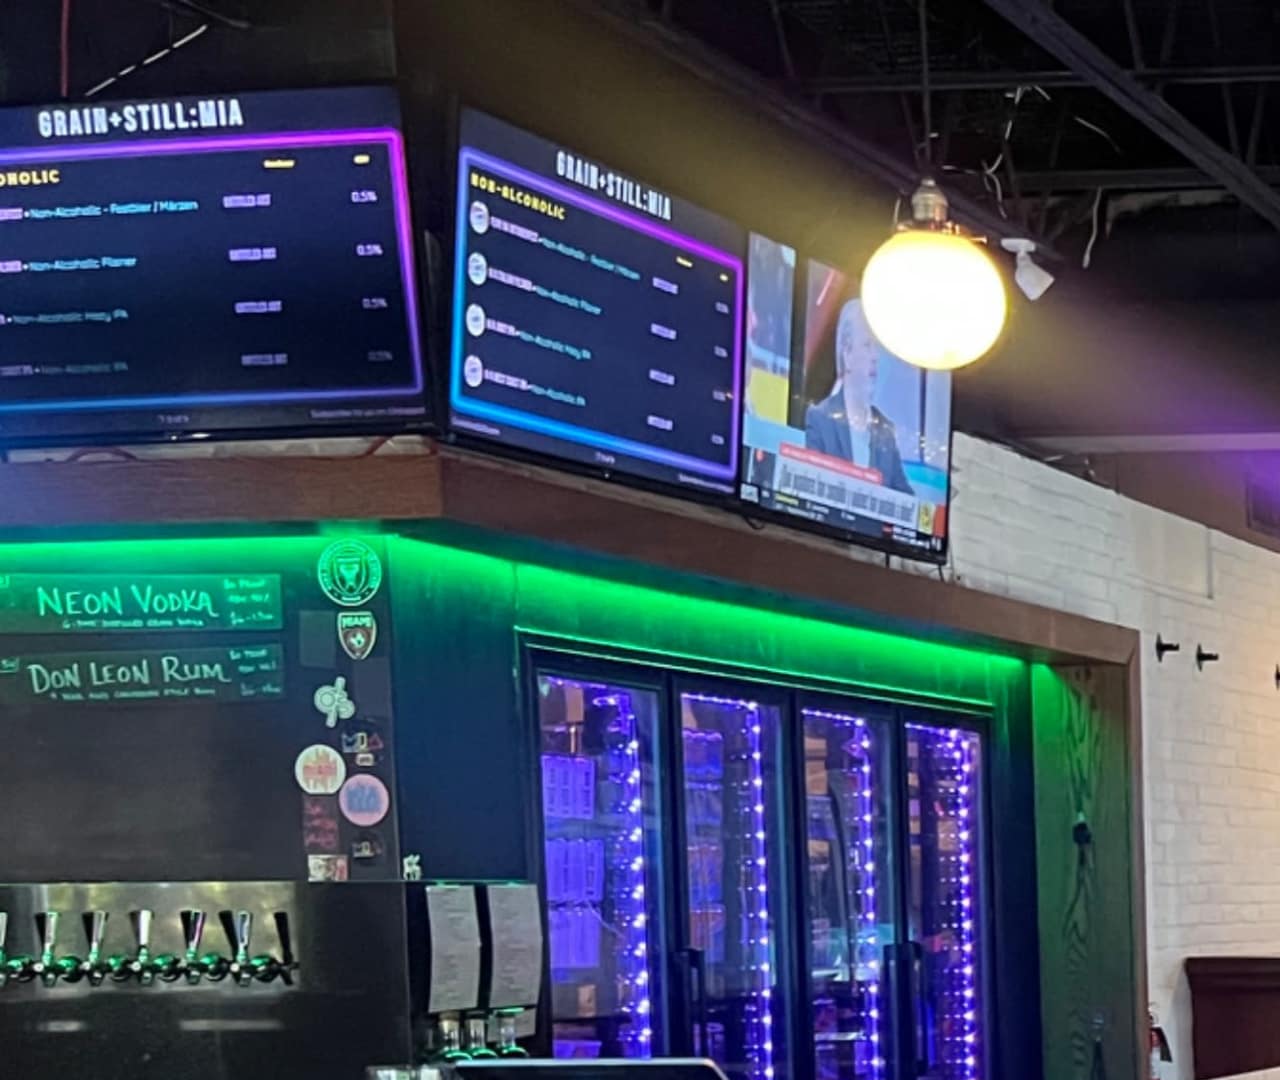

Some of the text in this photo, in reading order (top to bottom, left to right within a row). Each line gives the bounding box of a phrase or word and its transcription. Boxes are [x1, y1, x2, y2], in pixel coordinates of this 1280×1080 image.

[38, 99, 243, 137] GRAIN+STILL:MIA
[557, 150, 671, 220] GRAIN+STILL:MIA
[37, 586, 123, 616] NEON
[131, 584, 219, 618] VODKA
[27, 663, 81, 694] DON
[90, 659, 150, 686] LEON
[161, 656, 232, 683] RUM
